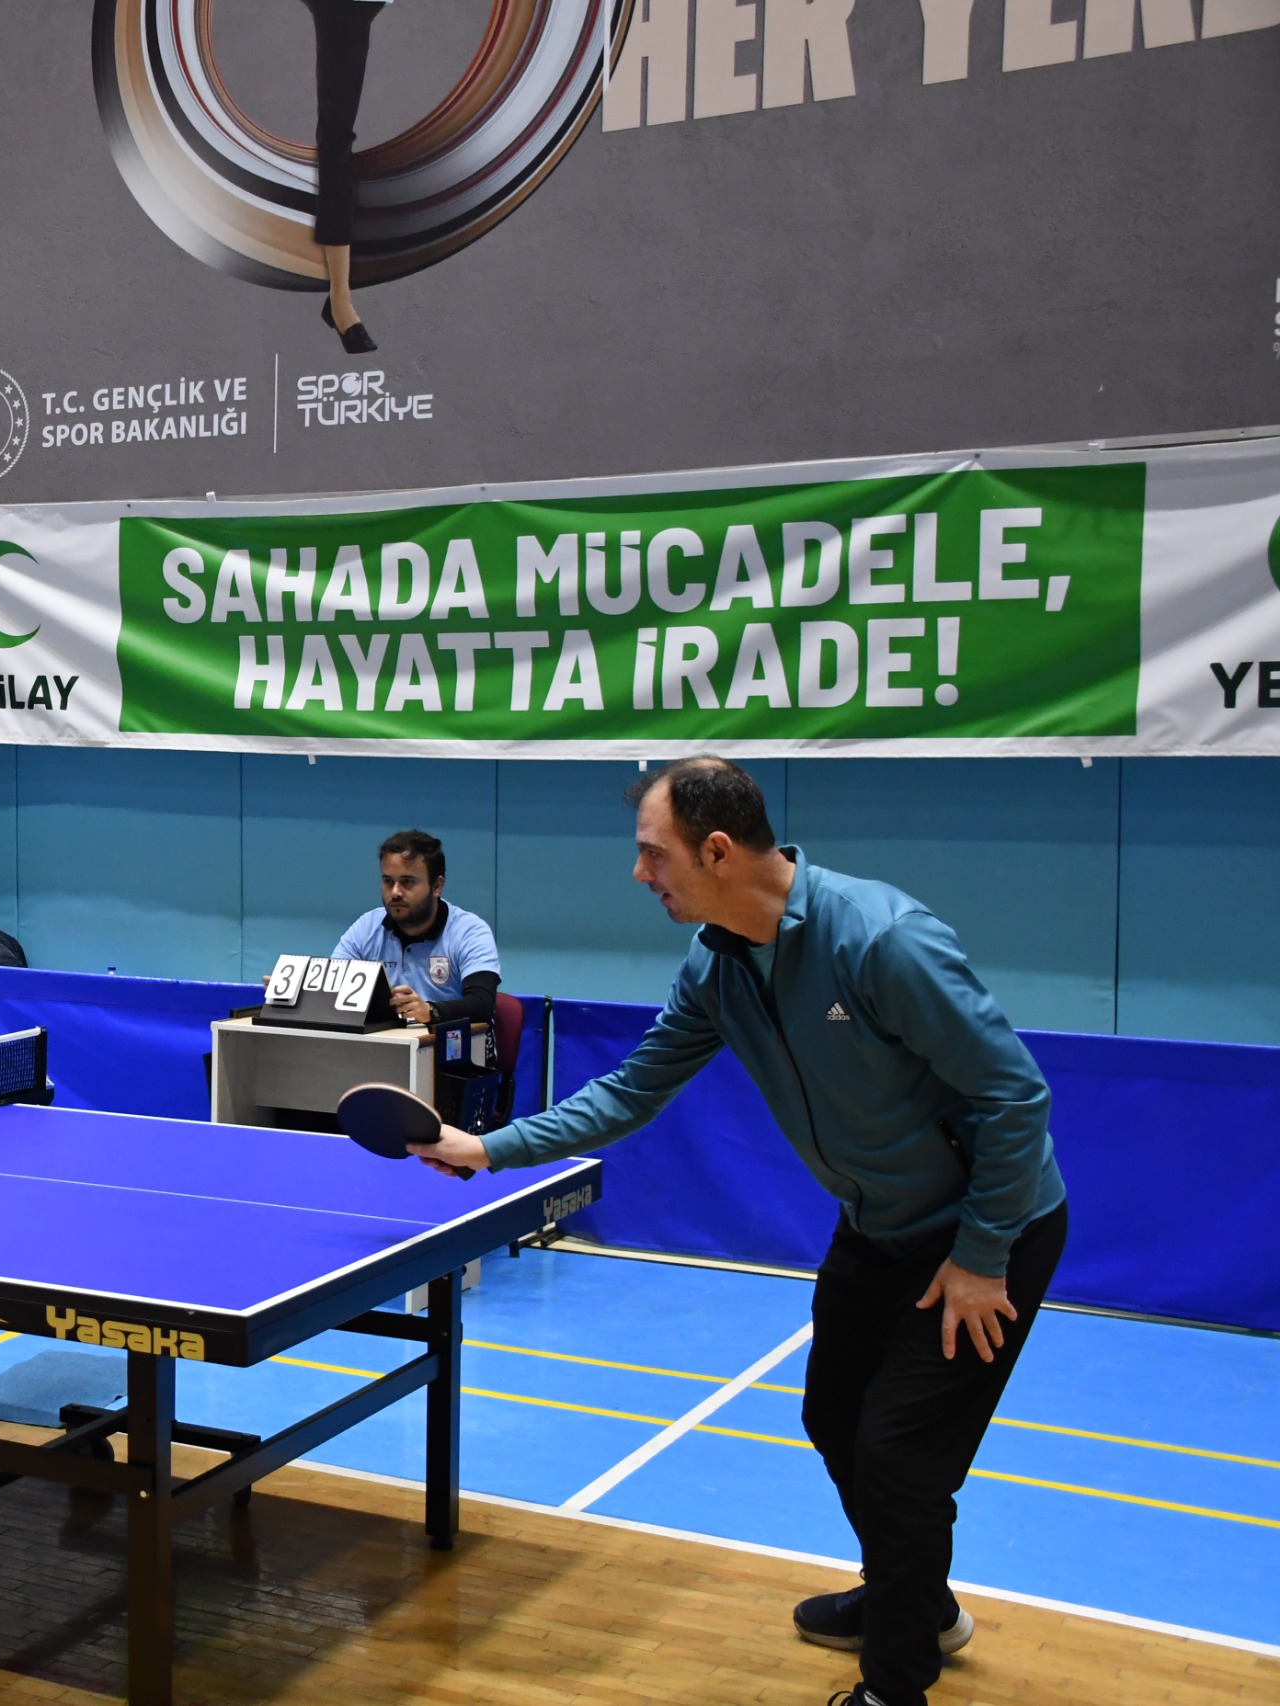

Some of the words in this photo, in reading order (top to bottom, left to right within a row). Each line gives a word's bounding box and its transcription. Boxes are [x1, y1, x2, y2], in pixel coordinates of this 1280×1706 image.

[42, 390, 85, 415] T.C.
[92, 377, 205, 414] GENÇLİK
[213, 377, 247, 402] VE
[297, 370, 385, 400] SPOR
[41, 422, 104, 448] SPOR
[111, 407, 247, 444] BAKANLIĞI
[297, 391, 434, 427] TÜRKİYE
[162, 538, 489, 624] SAHADA
[516, 507, 1072, 618] MÜCADELE,
[232, 630, 604, 712] HAYATTA
[273, 964, 295, 996] 3
[306, 964, 323, 989] 2
[330, 966, 340, 991] 1
[342, 972, 367, 1007] 2
[543, 1184, 592, 1224] Yasaka
[45, 1304, 205, 1361] Yasaka
